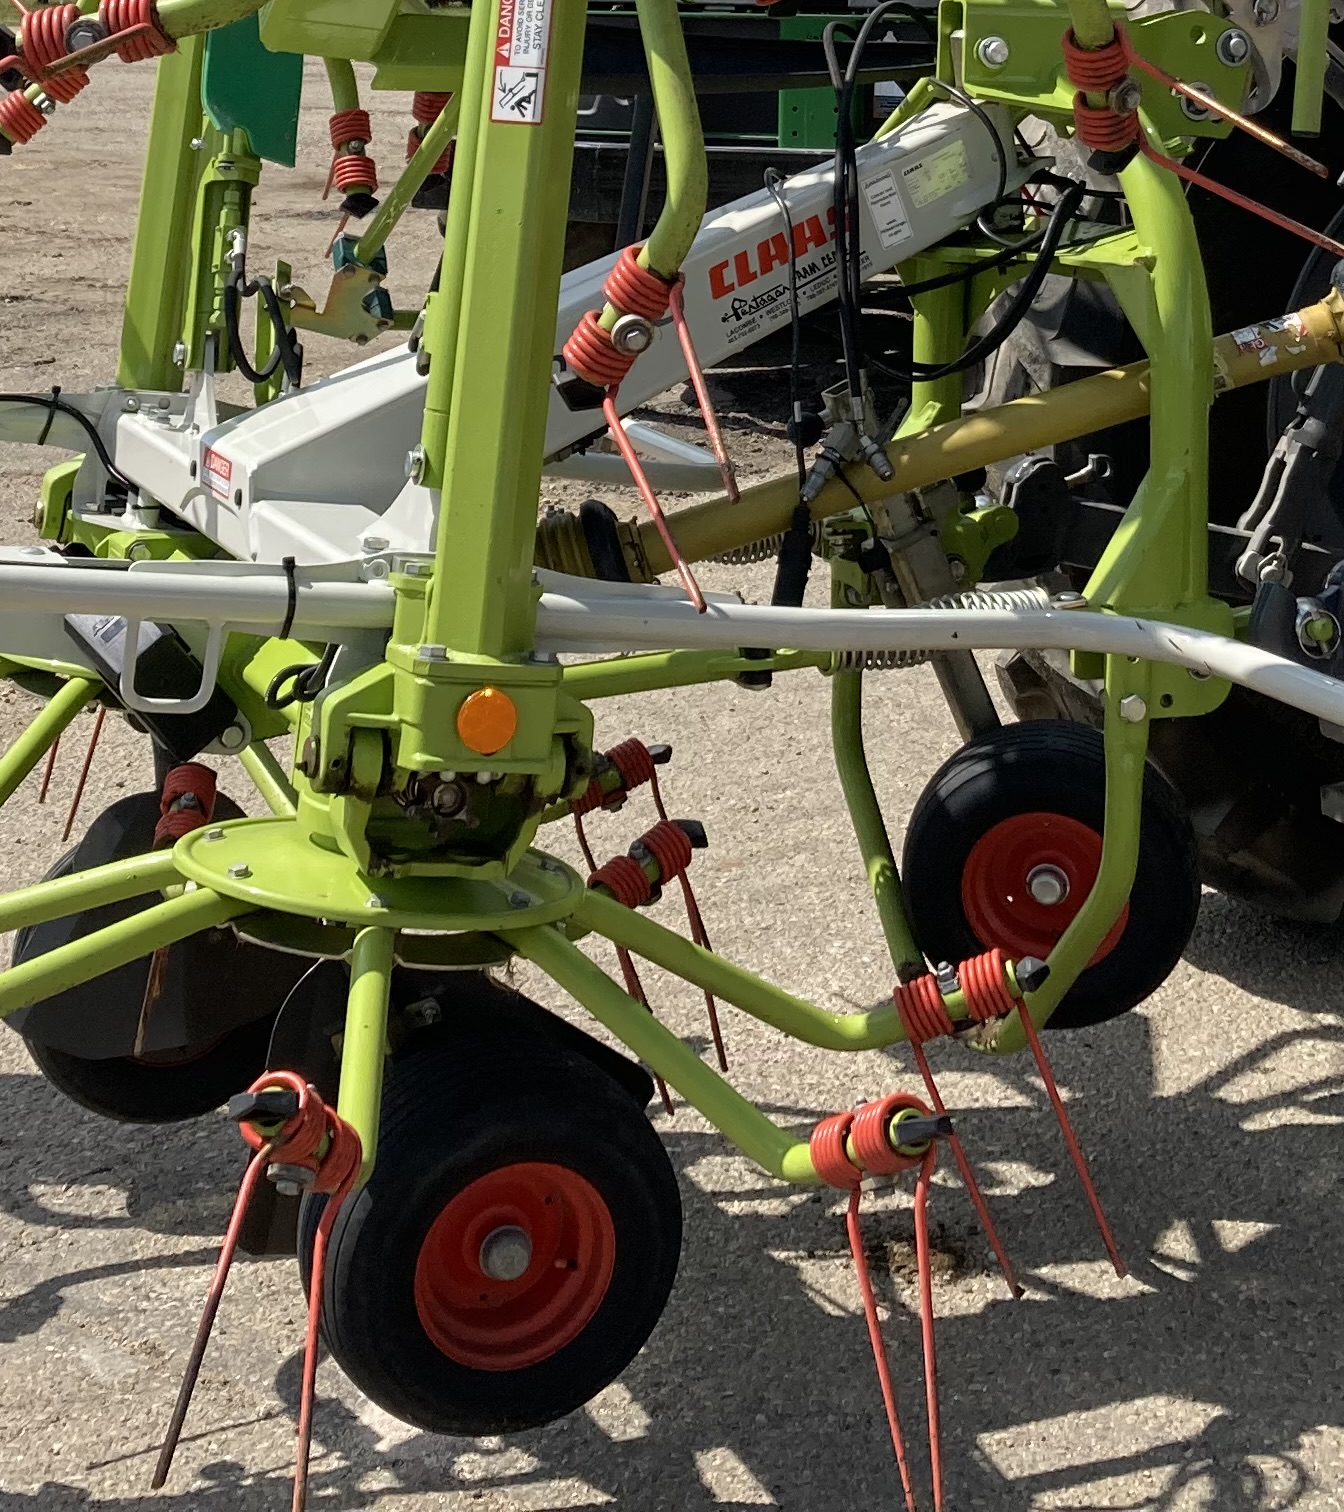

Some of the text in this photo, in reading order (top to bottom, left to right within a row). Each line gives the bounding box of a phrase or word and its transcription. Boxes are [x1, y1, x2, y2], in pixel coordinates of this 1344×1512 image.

[526, 10, 533, 23] OR
[516, 17, 524, 42] AVOID
[523, 24, 531, 55] INJURY
[533, 24, 543, 50] STAY
[514, 44, 522, 55] TO
[793, 261, 821, 282] ARM
